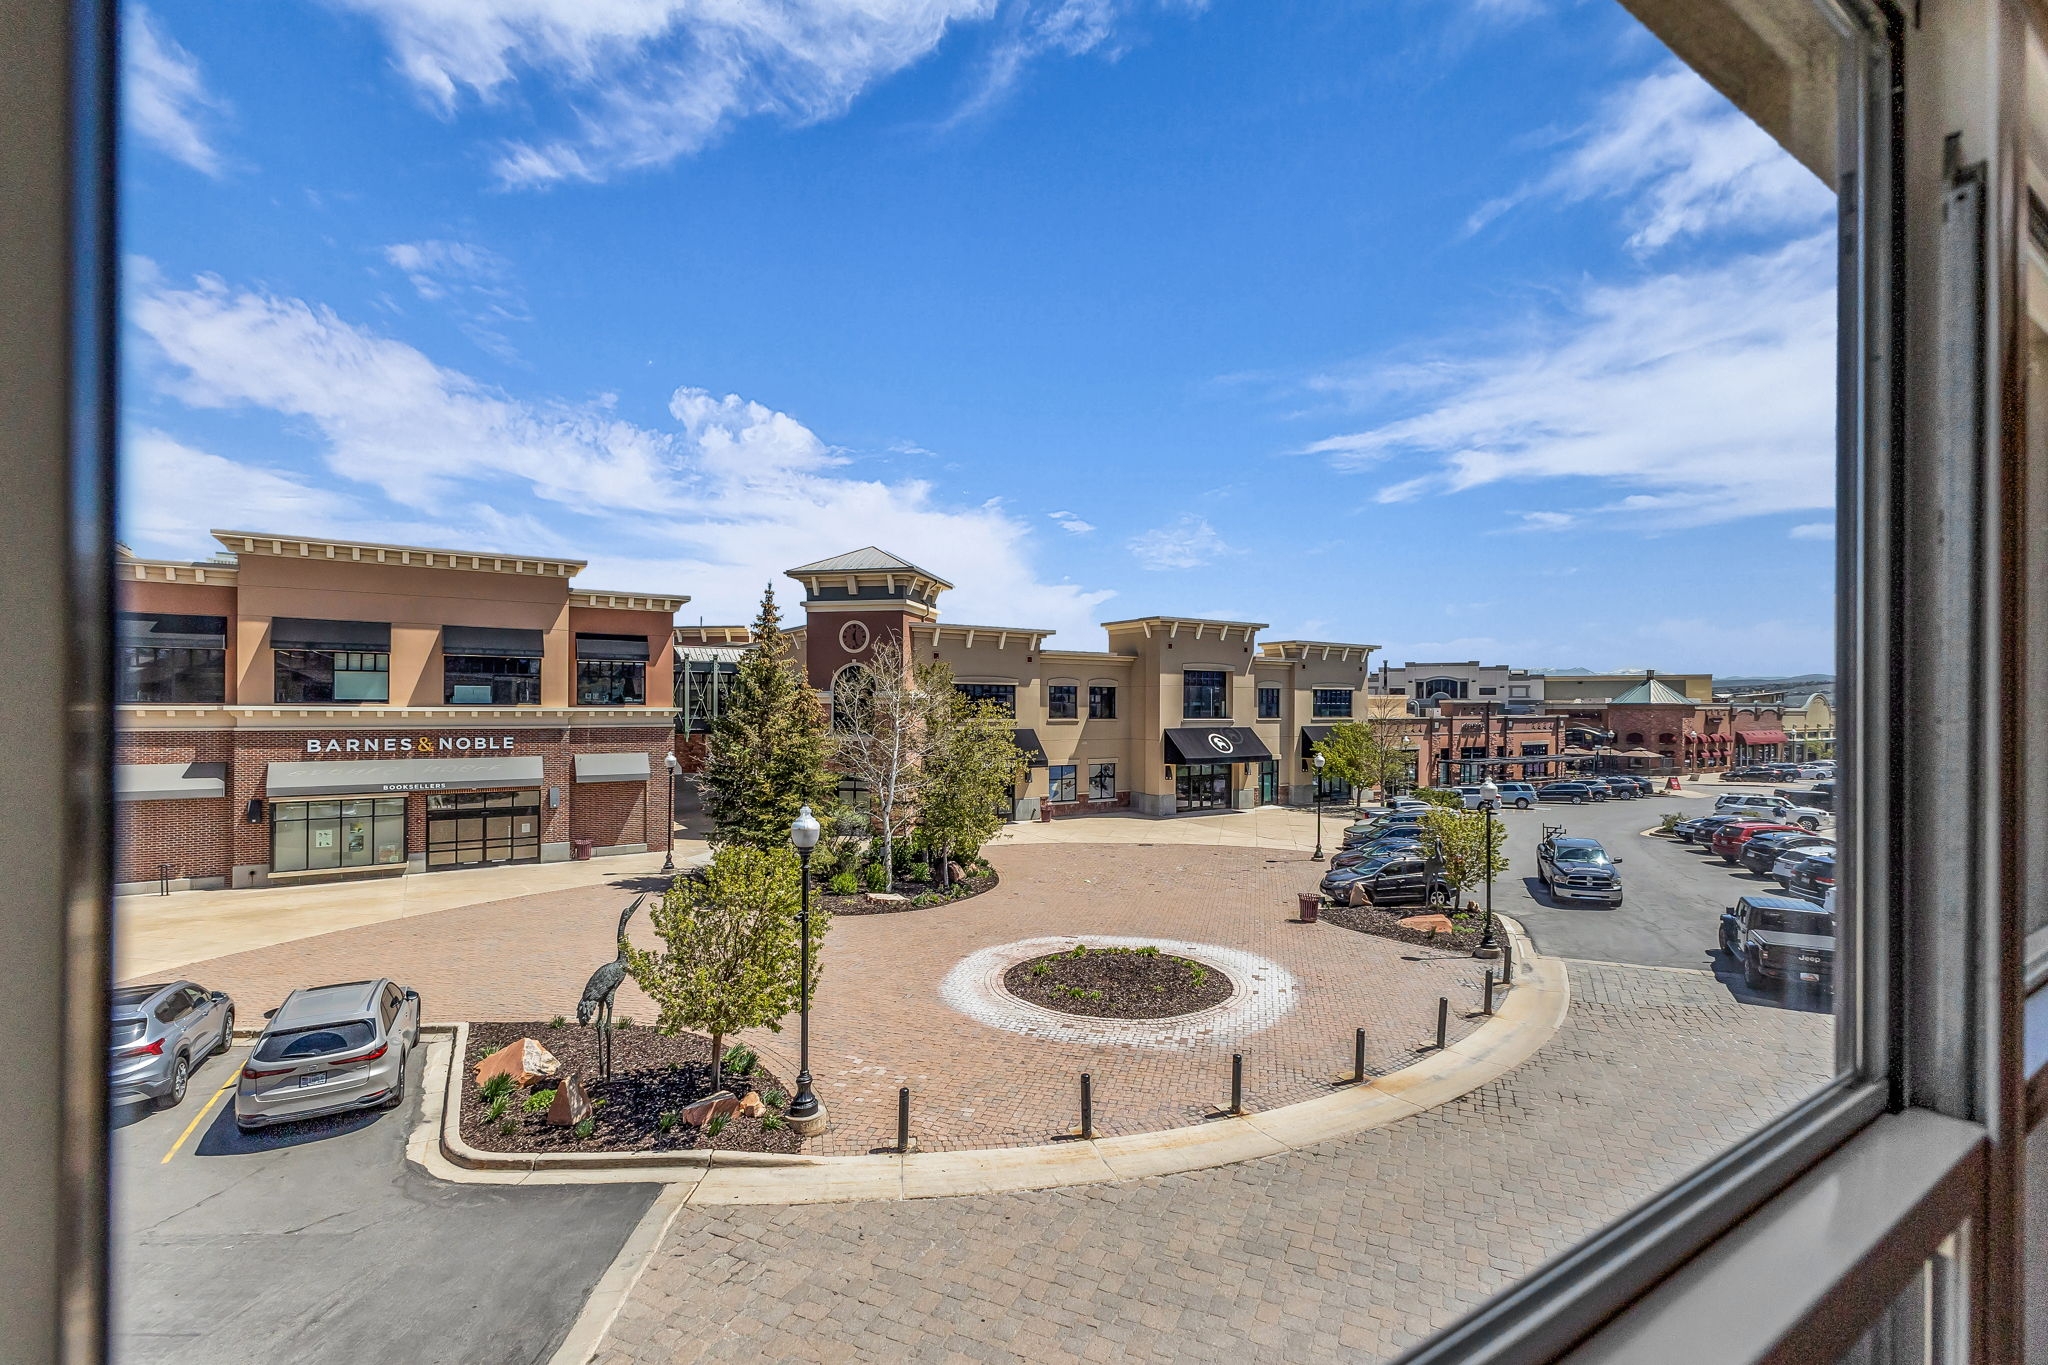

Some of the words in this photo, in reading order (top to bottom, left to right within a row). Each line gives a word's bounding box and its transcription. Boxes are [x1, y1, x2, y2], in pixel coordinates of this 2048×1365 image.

[306, 738, 412, 753] BARNES
[417, 736, 434, 752] &
[439, 736, 515, 750] NOBLE
[383, 782, 446, 791] BOOKSELLERS
[1798, 954, 1821, 964] Jeep
